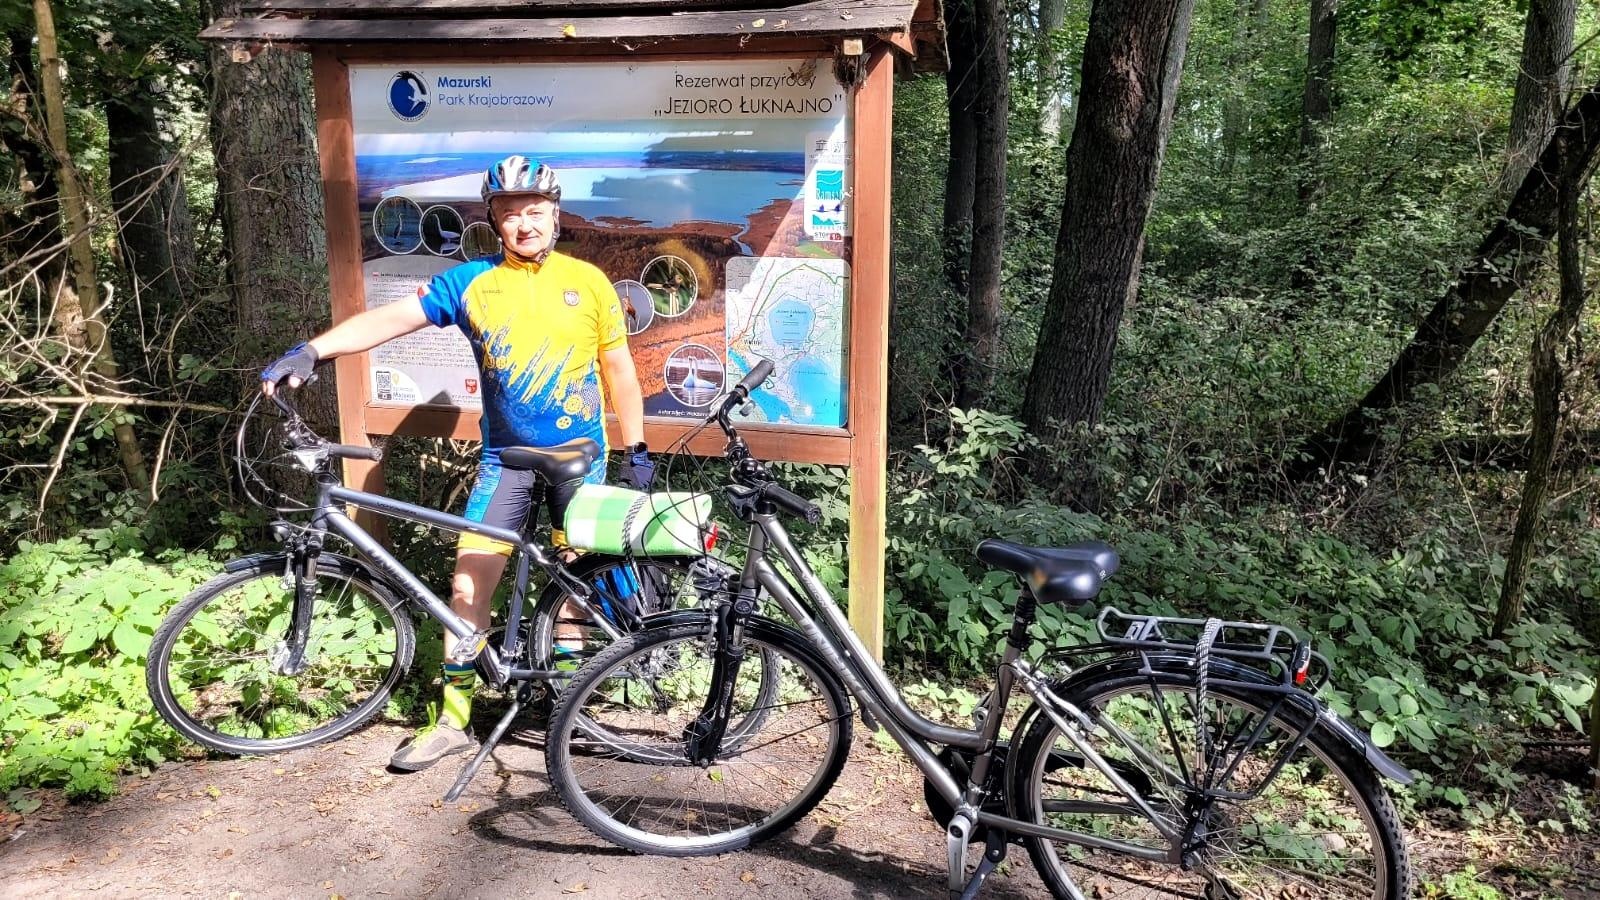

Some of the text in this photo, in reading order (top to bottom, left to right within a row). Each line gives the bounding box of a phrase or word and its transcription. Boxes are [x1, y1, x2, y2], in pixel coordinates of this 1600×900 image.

[437, 76, 492, 88] Mazurski
[675, 74, 745, 89] Rezerwat
[438, 93, 554, 108] Park Krajobrazowy
[800, 617, 876, 705] UNIBIKE
